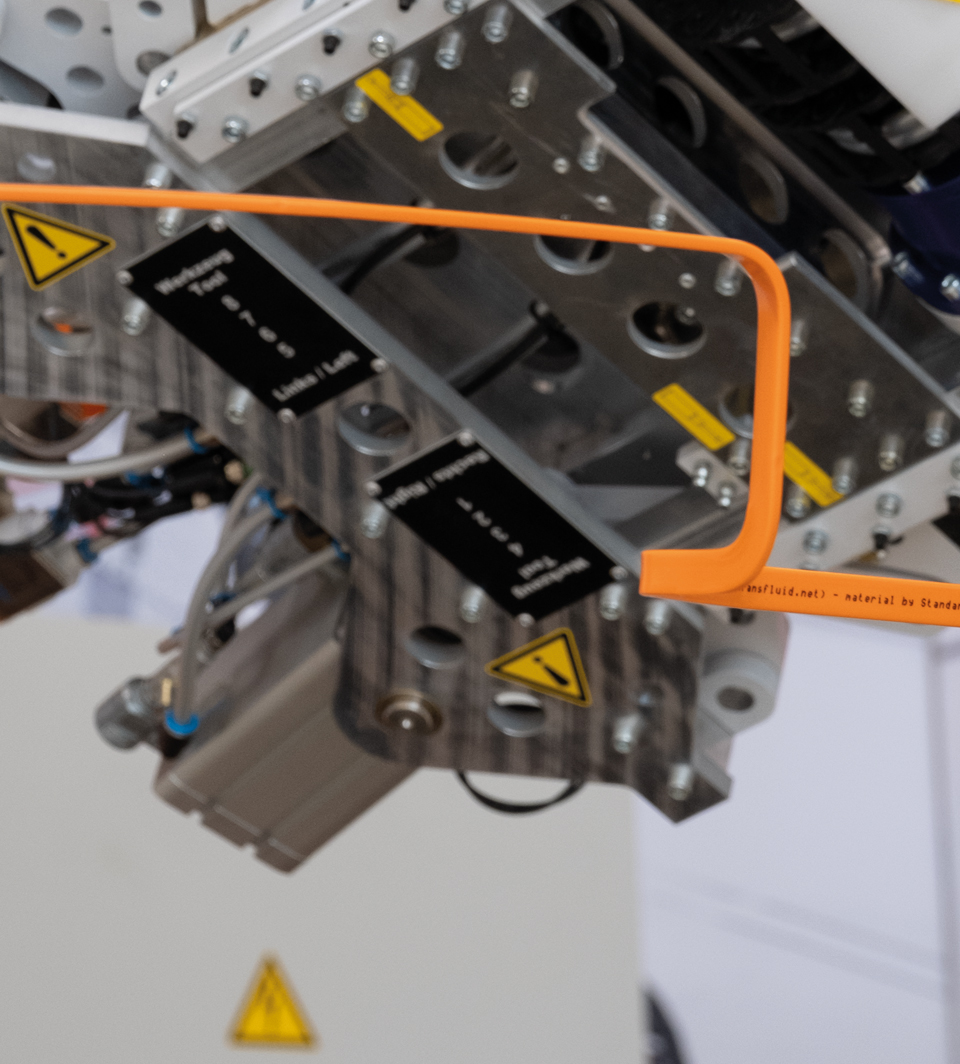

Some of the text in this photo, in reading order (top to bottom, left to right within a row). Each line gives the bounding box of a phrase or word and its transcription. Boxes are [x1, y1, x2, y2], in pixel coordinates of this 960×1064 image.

[188, 269, 228, 296] Tool
[239, 309, 256, 327] 7
[845, 592, 894, 605] material
[902, 596, 914, 607] by
